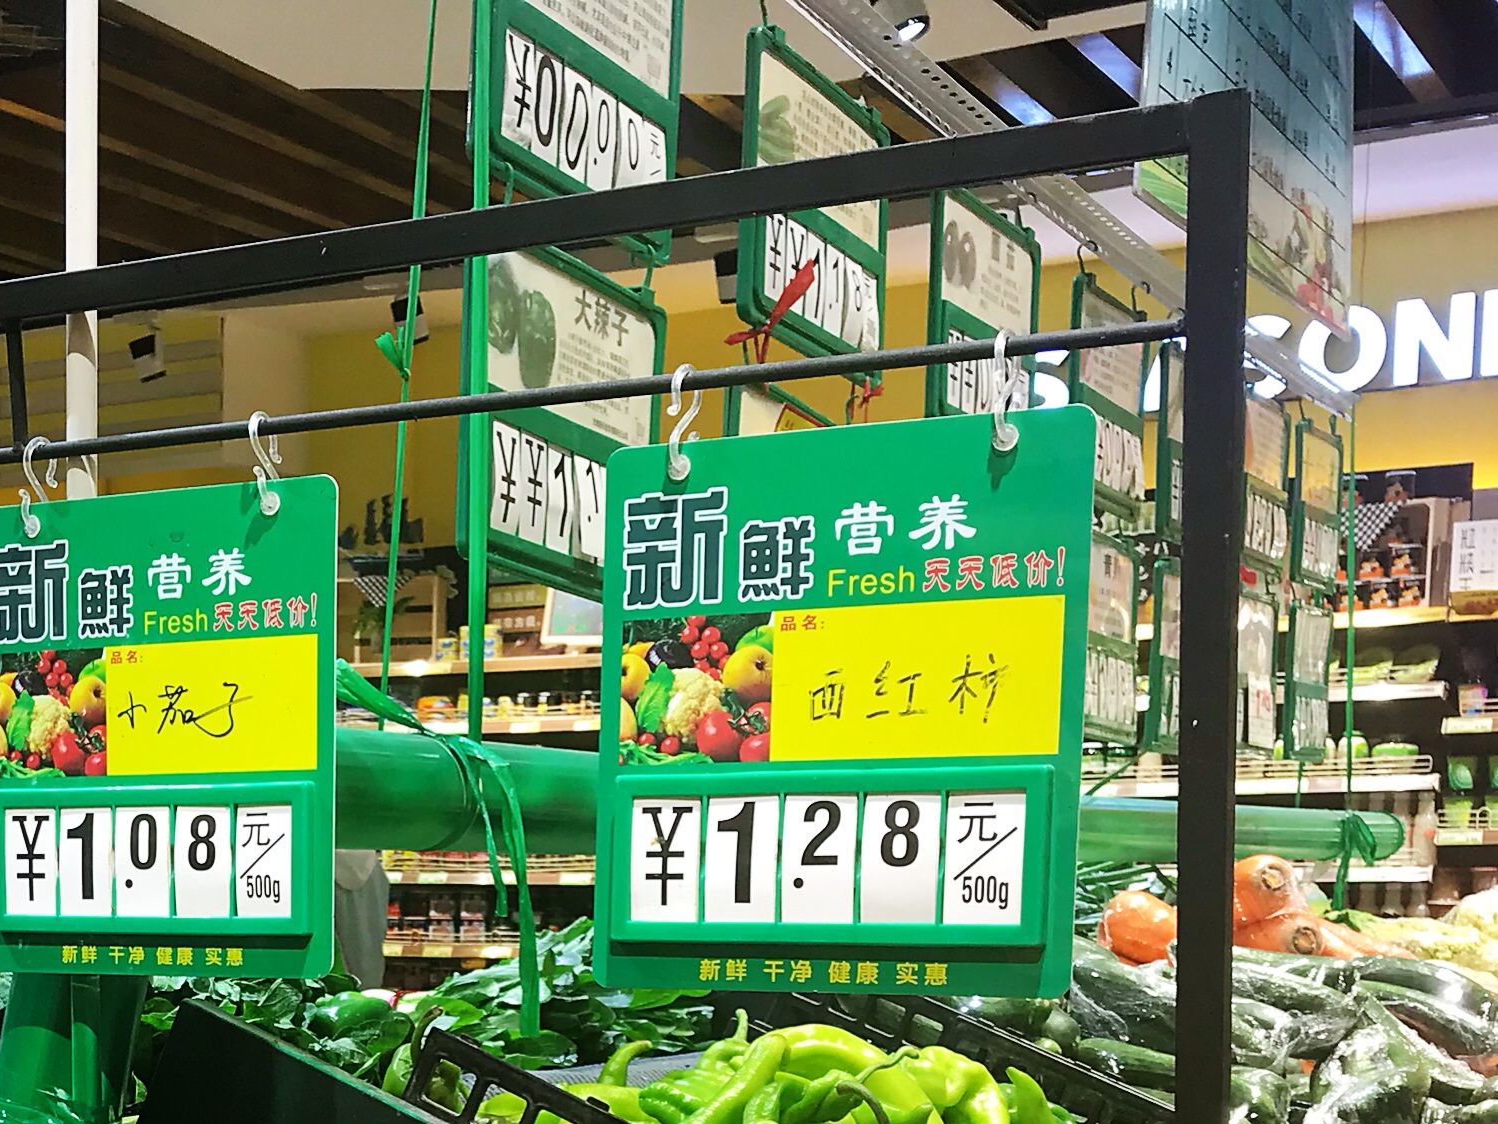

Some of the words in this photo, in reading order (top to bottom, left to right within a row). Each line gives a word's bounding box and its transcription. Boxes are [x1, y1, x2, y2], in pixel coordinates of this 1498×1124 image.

[574, 289, 629, 347] 大辣子
[835, 494, 977, 555] 营养
[147, 548, 253, 600] 营养
[827, 565, 915, 597] Fresh
[143, 610, 208, 635] Fresh
[117, 682, 253, 739] 小茄子
[808, 653, 1012, 724] 西红柿
[62, 945, 97, 964] 新鲜
[108, 946, 145, 965] 干净
[156, 946, 194, 966] 健康
[205, 947, 244, 967] 实惠
[699, 959, 748, 982] 新鲜
[762, 960, 812, 983] 干净
[829, 961, 879, 985] 健康
[896, 963, 949, 986] 实惠
